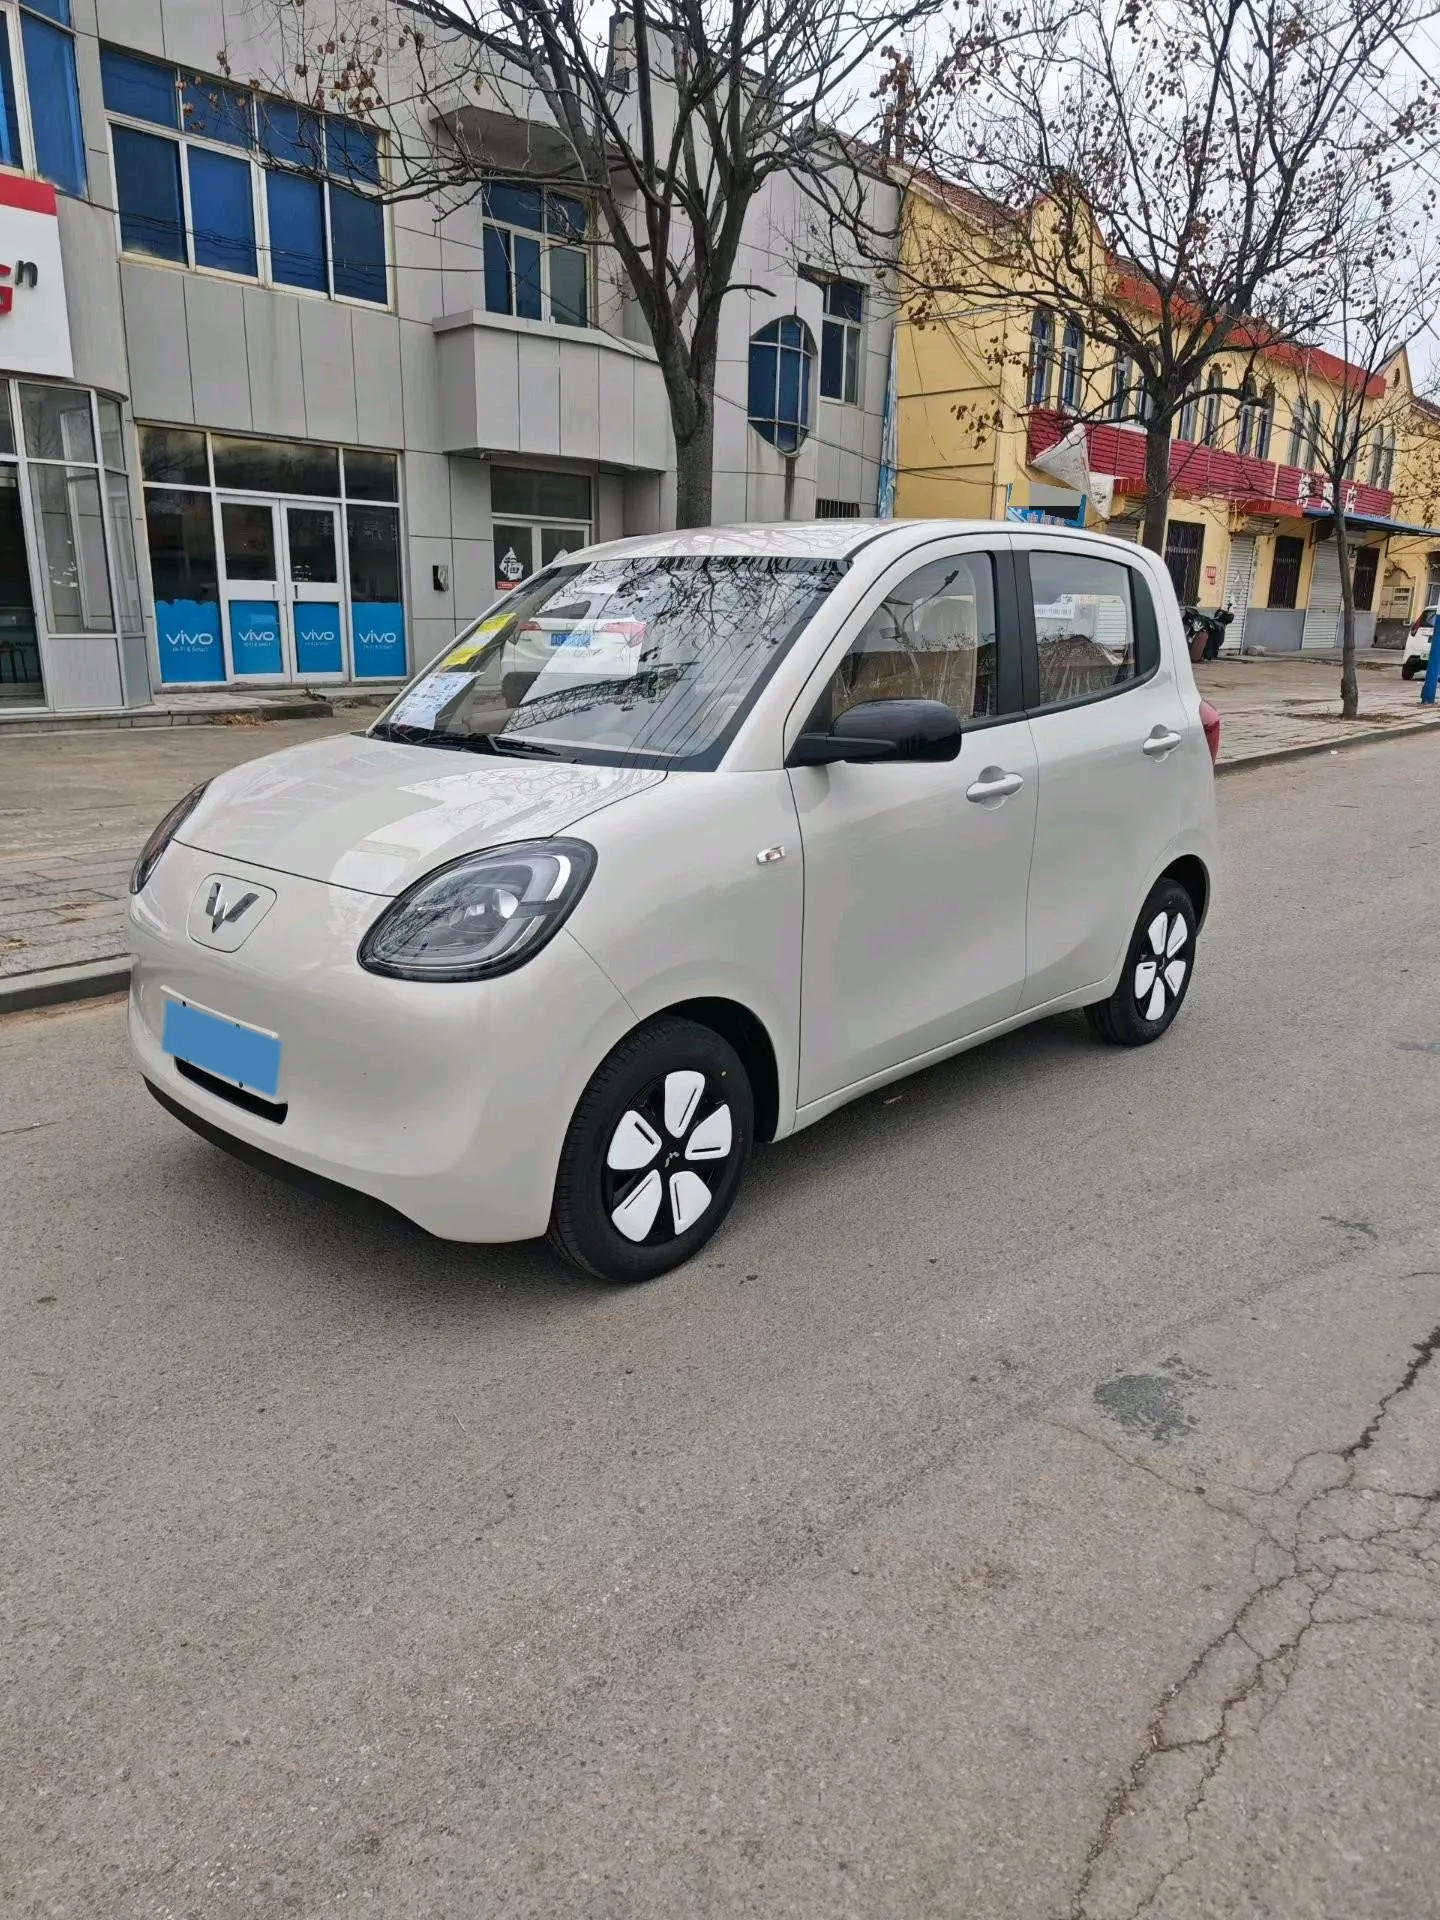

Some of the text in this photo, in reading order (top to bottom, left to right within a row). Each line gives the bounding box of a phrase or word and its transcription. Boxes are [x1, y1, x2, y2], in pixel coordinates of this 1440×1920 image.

[166, 630, 213, 645] vivo
[238, 629, 275, 641] vivo
[301, 629, 334, 641] vivo
[359, 630, 396, 643] vivo
